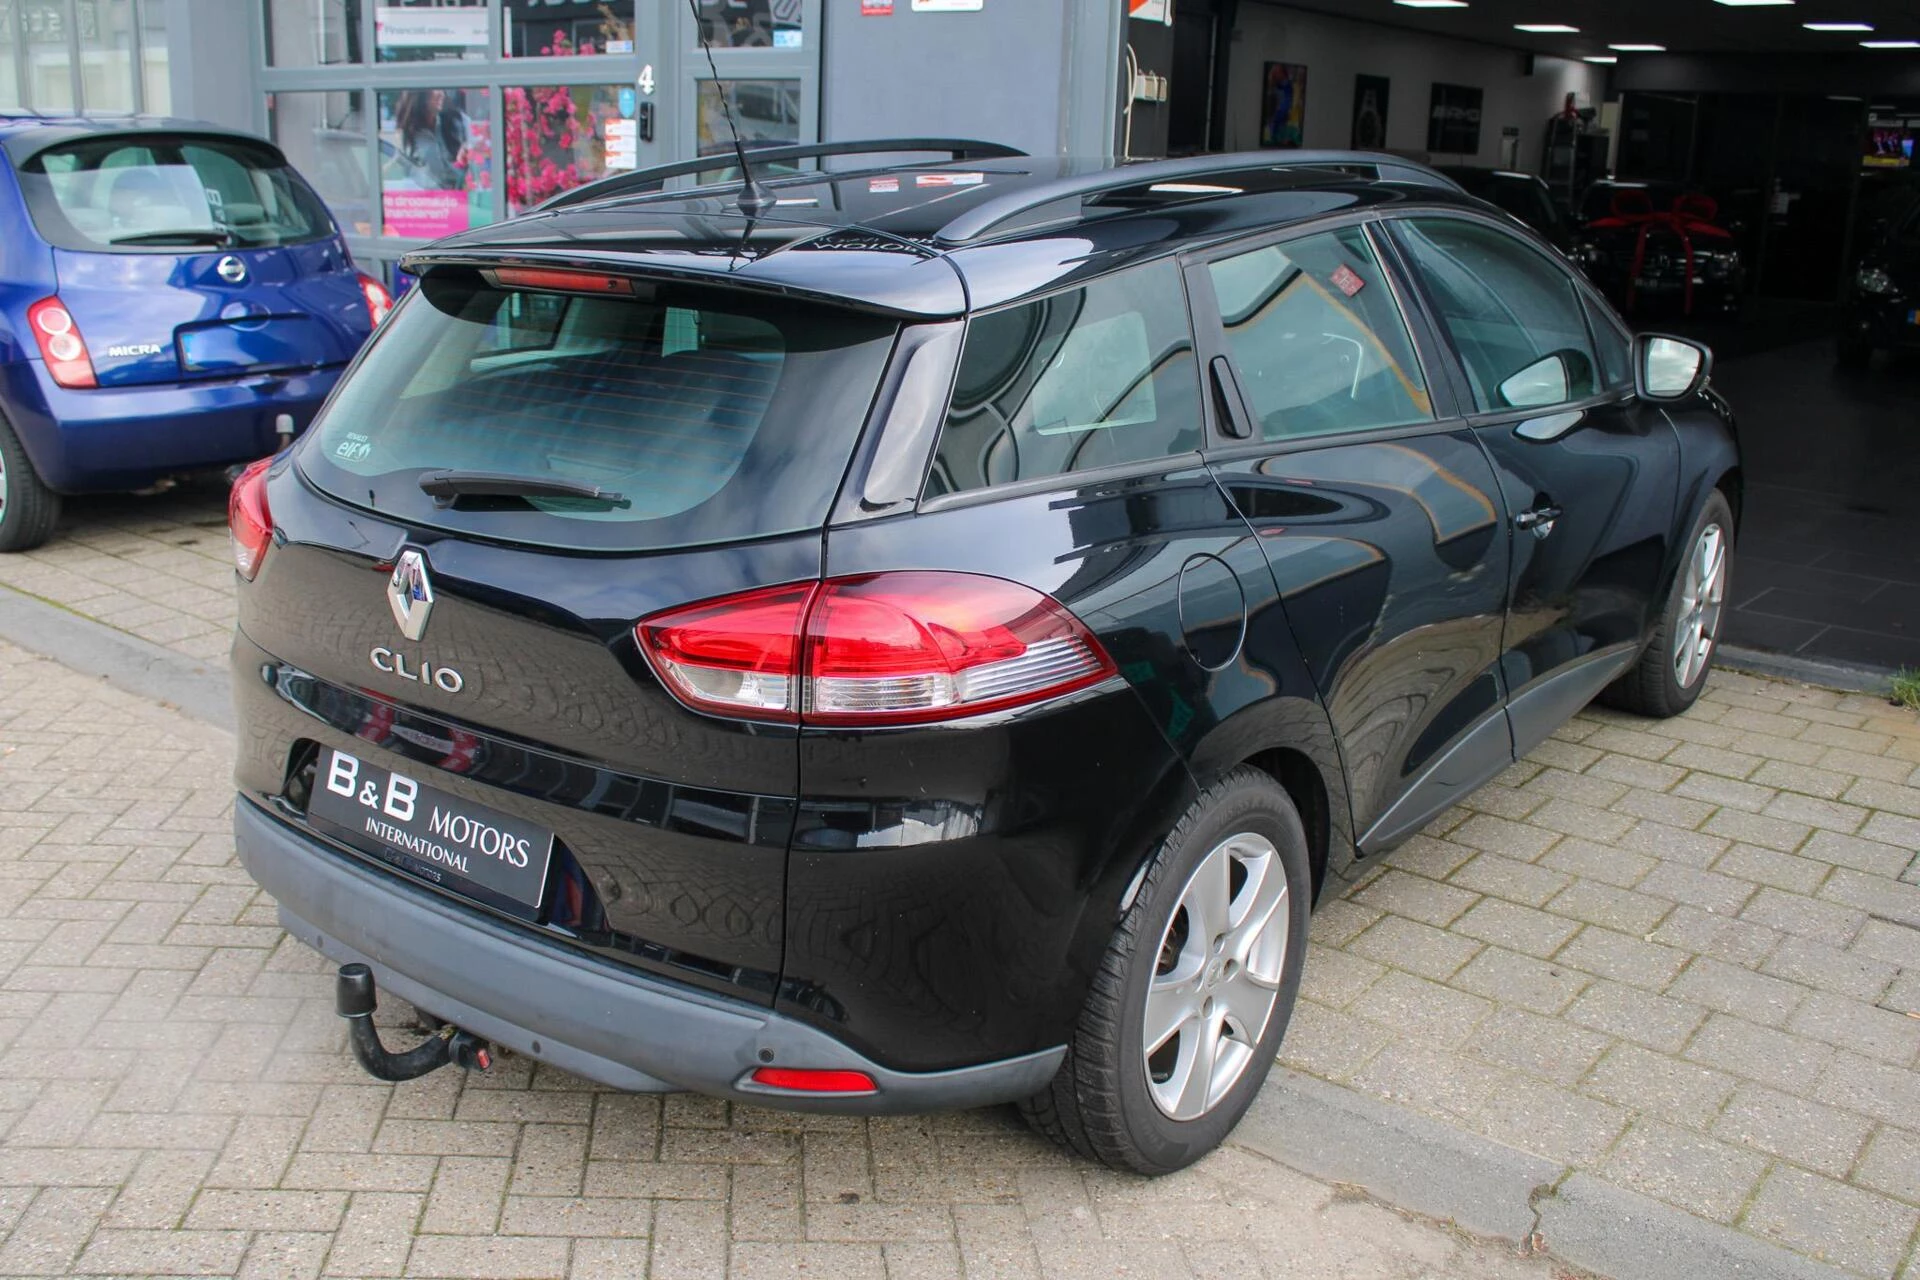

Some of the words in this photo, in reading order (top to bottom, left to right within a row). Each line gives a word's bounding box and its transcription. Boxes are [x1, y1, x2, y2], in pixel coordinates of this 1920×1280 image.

[638, 64, 655, 95] 4
[108, 343, 161, 357] MICRA
[369, 647, 463, 693] CLIO
[365, 816, 471, 874] INTERNATIONAL
[429, 806, 531, 868] MOTORS
